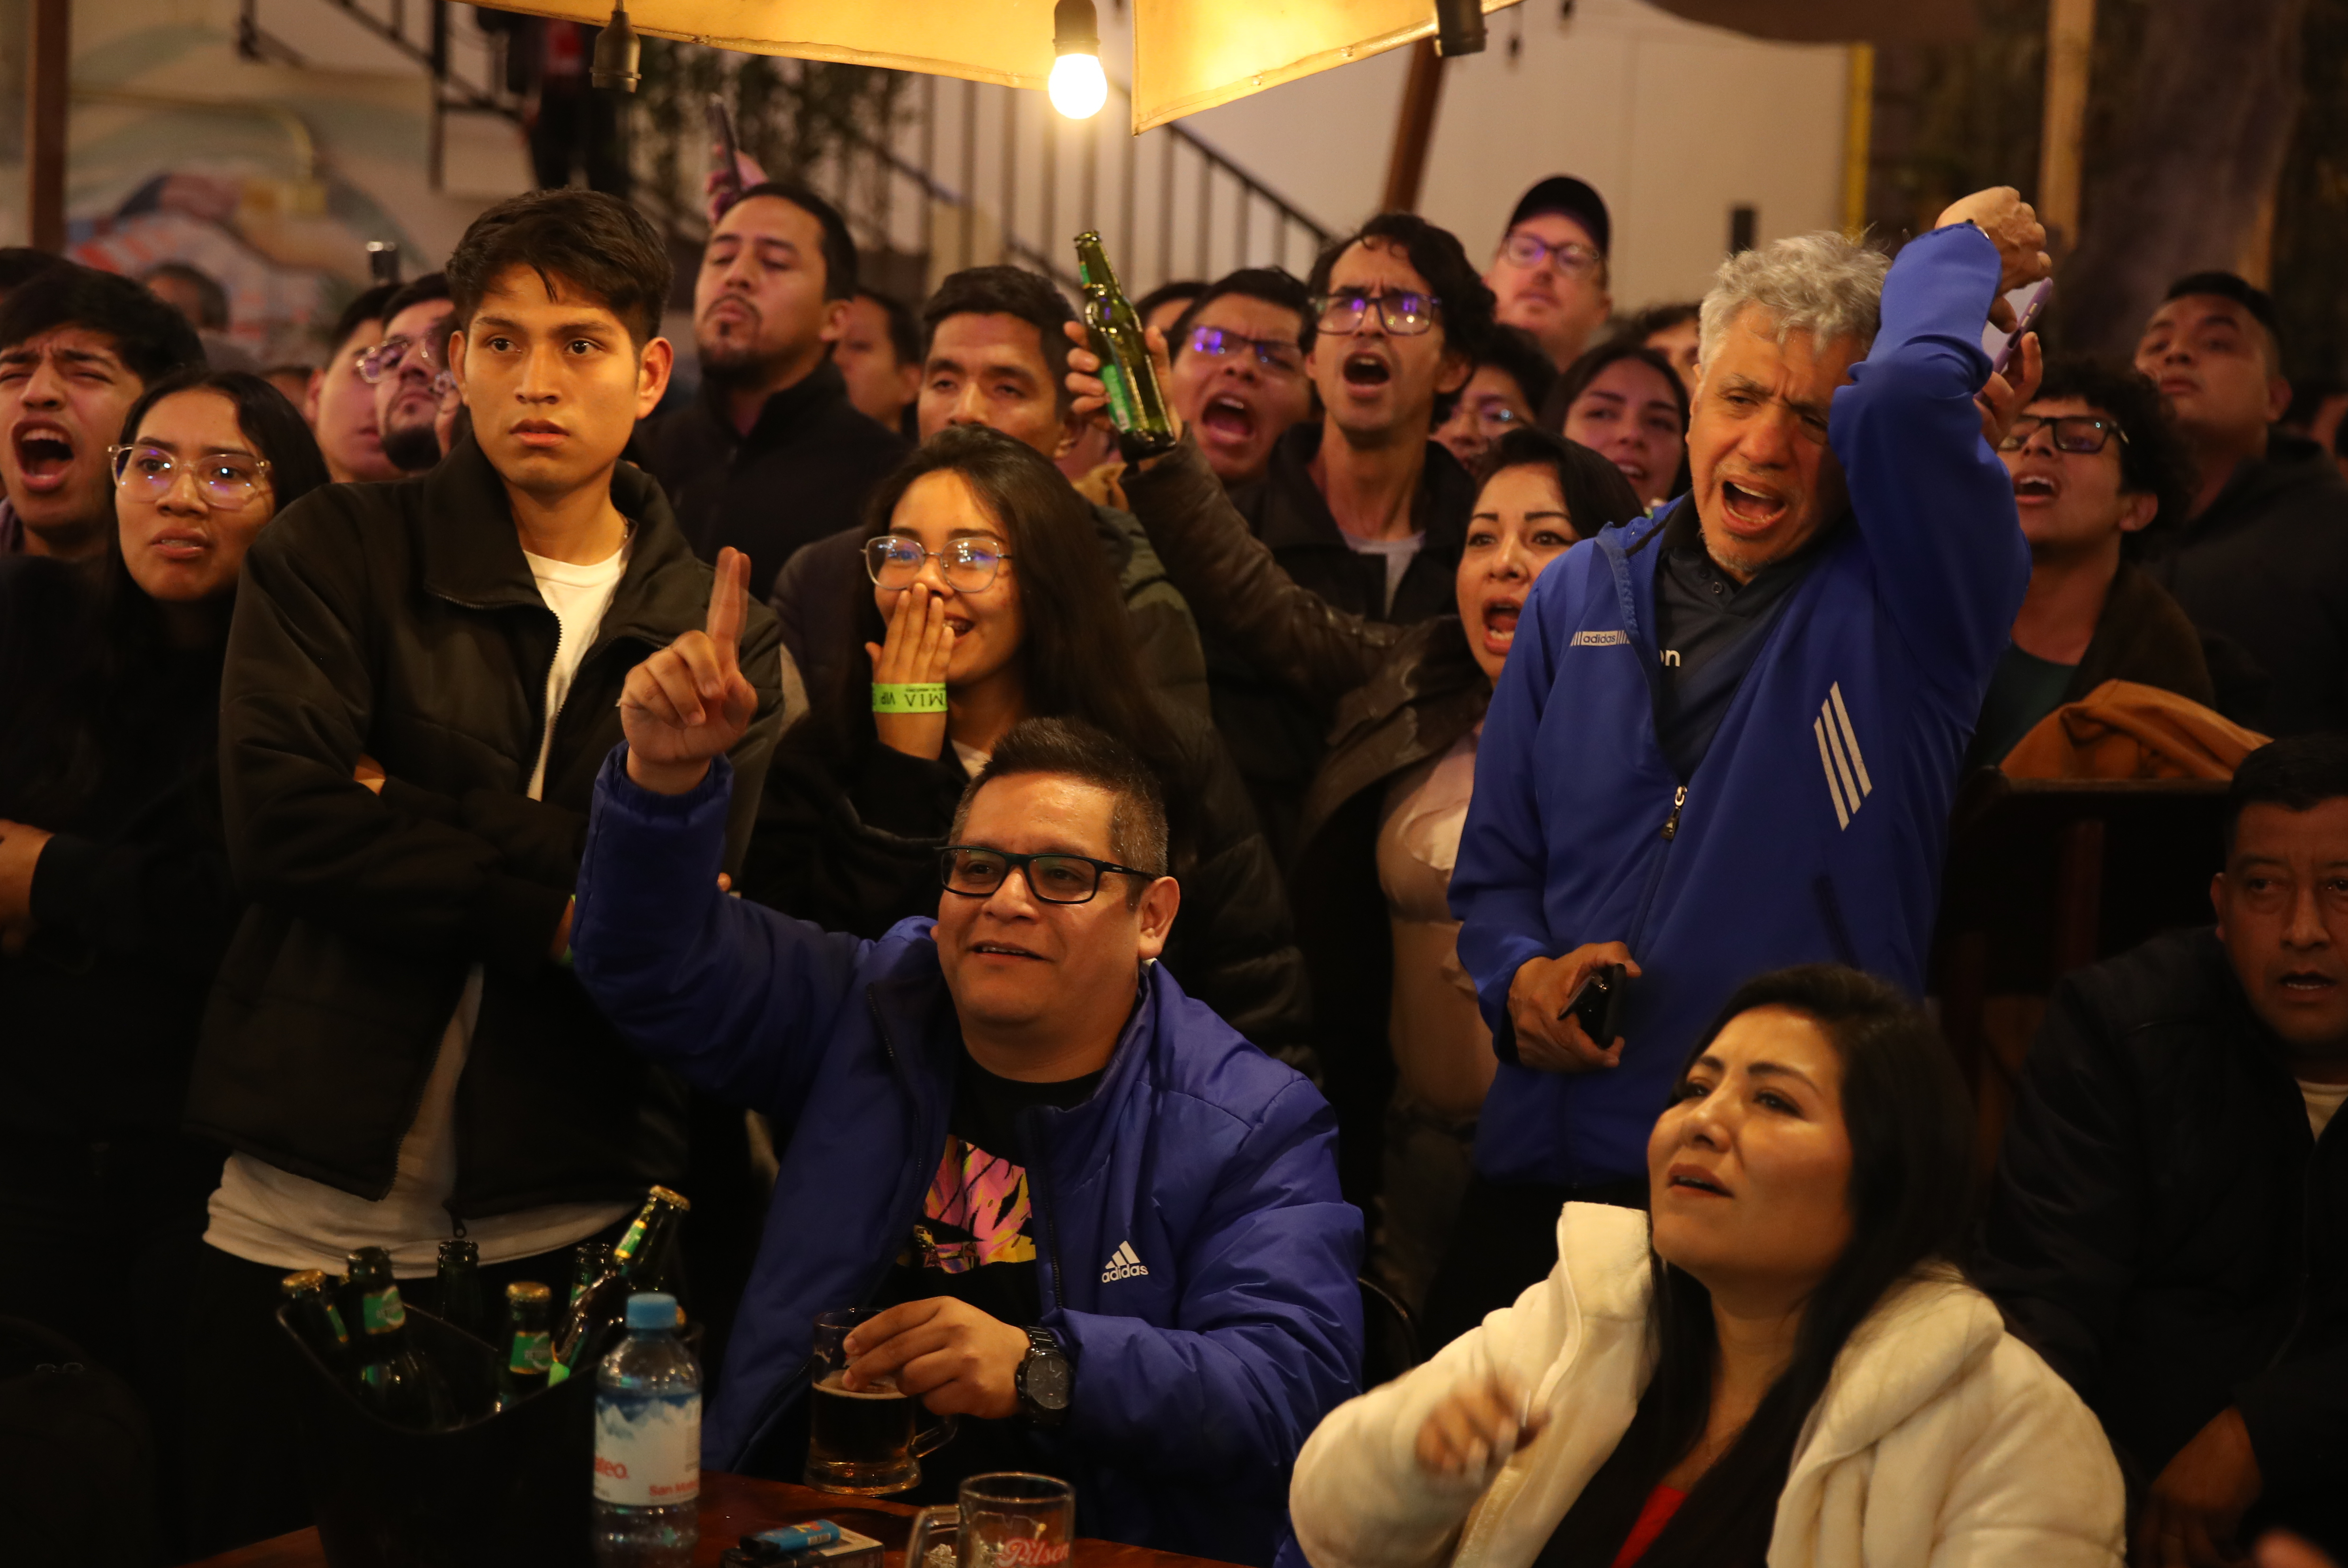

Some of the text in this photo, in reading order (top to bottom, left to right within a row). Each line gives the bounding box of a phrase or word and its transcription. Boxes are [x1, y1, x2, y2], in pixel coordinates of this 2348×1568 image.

[1583, 634, 1616, 643] adidas
[1660, 650, 1681, 667] n
[904, 693, 943, 707] MIA
[1102, 1264, 1149, 1283] adidas
